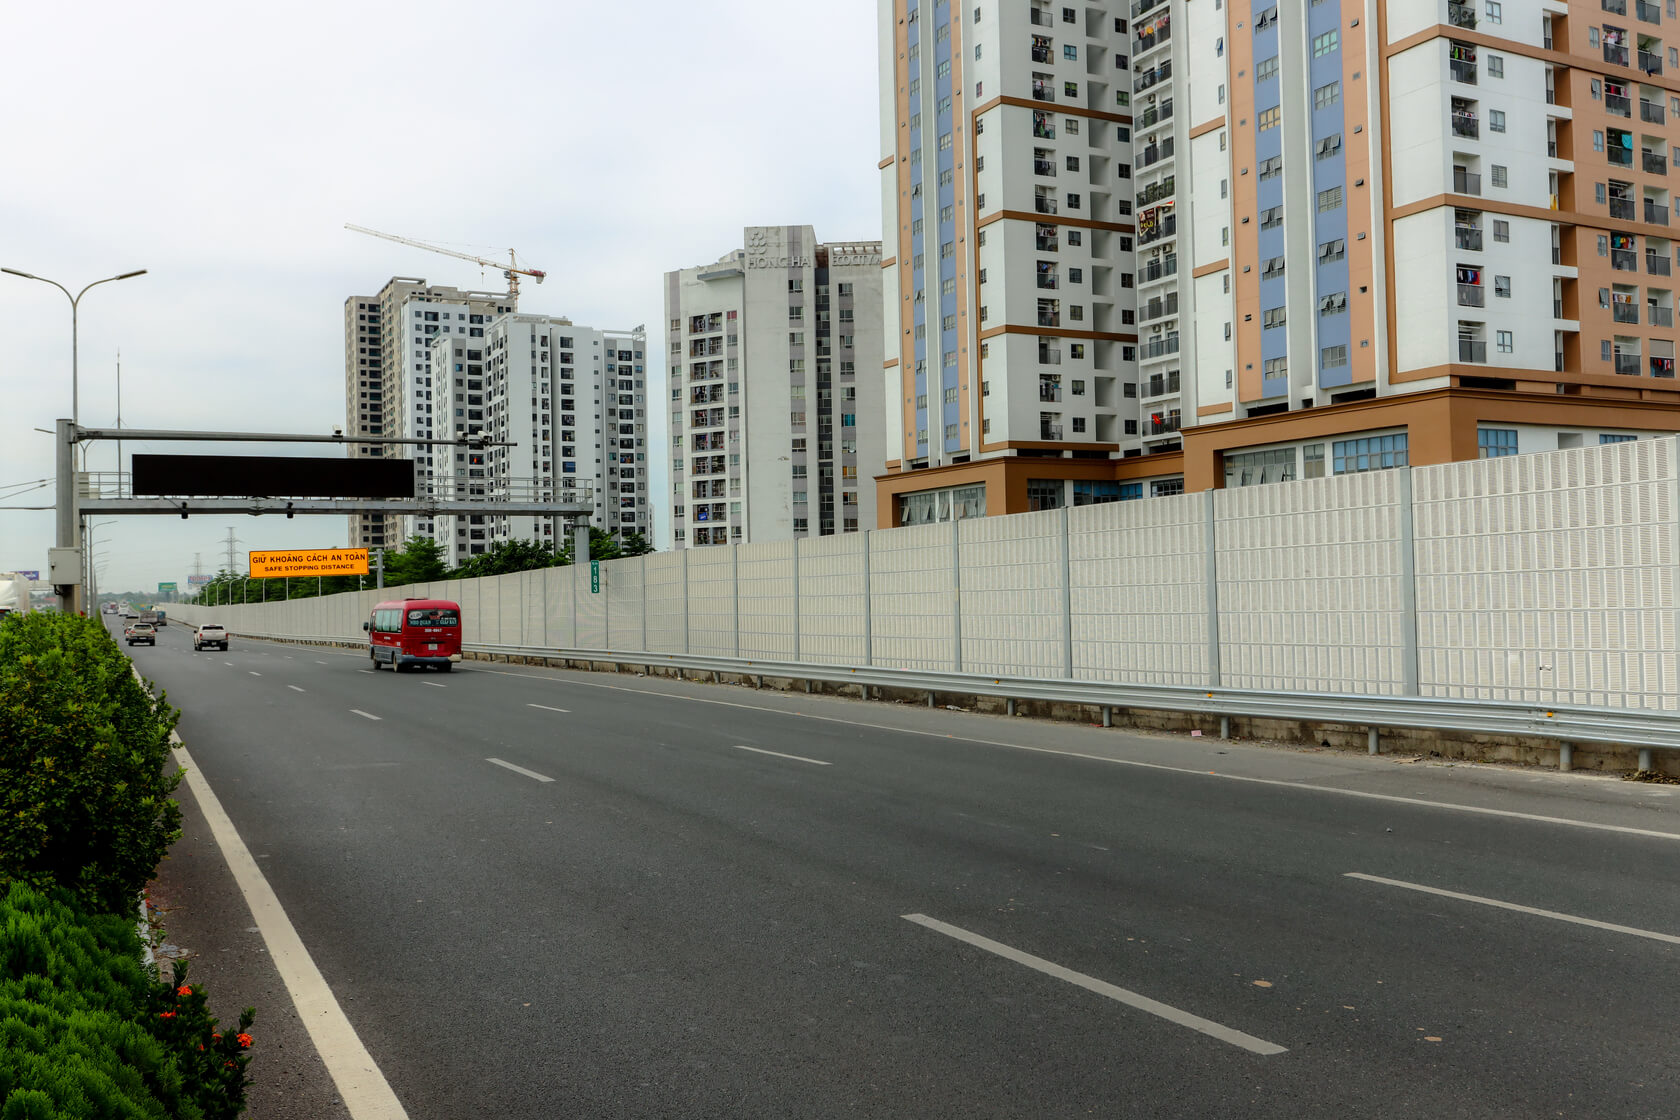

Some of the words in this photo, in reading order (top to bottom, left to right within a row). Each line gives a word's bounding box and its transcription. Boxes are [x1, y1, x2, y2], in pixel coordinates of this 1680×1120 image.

[306, 553, 328, 562] CÁCH
[331, 553, 342, 561] AN
[345, 551, 366, 560] TOÀN
